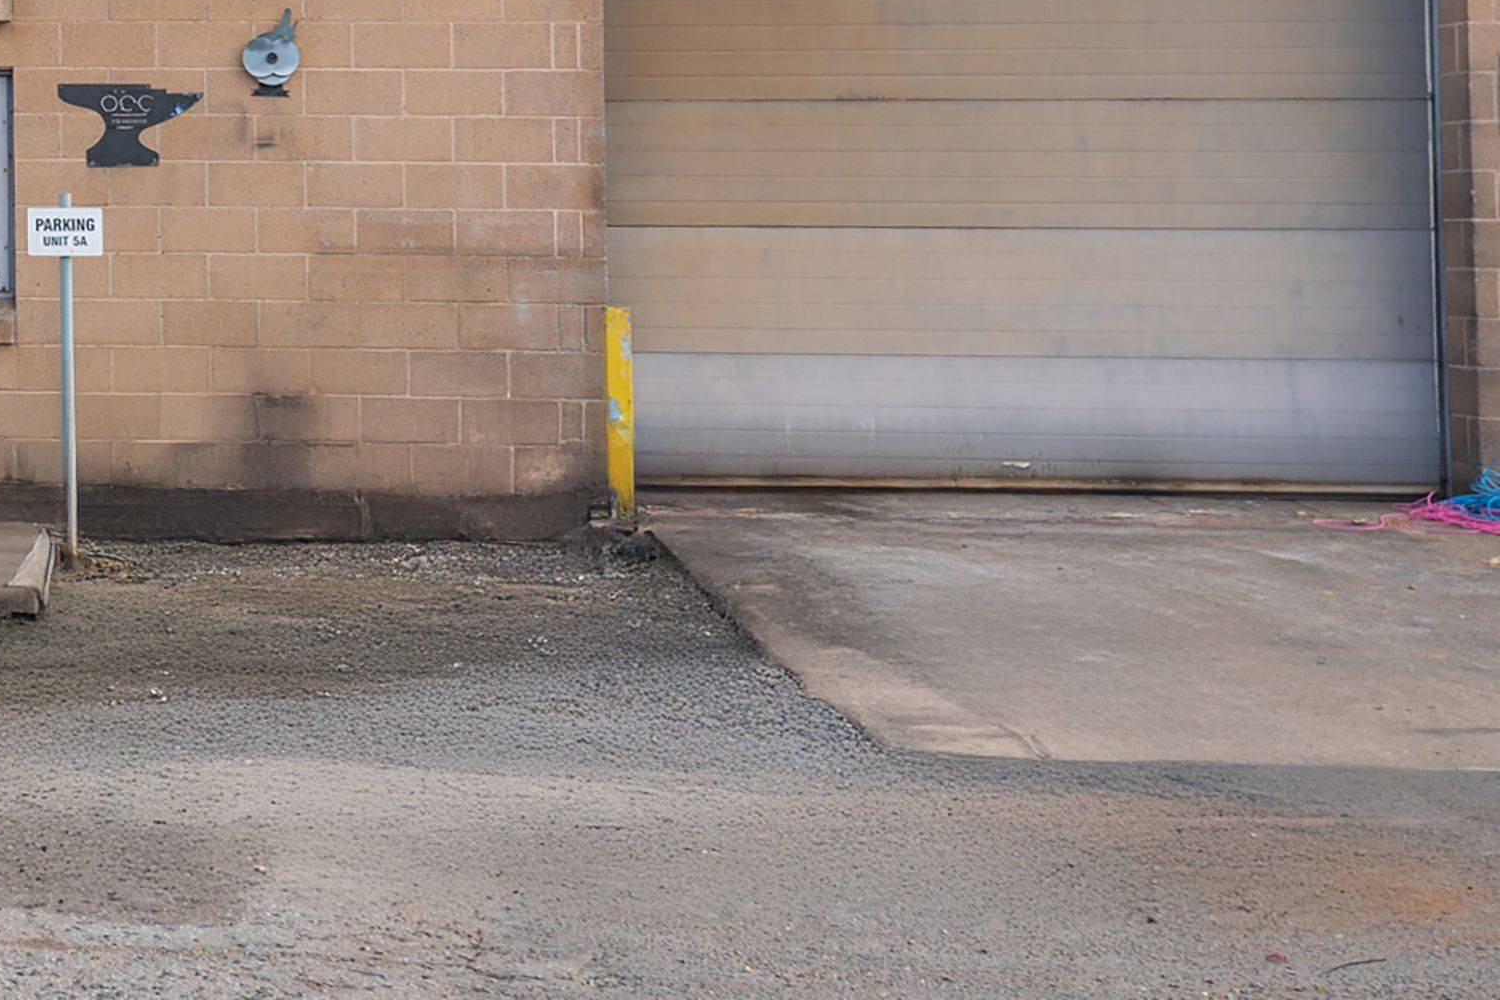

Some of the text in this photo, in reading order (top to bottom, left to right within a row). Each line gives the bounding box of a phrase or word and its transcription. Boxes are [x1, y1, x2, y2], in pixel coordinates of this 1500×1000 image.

[35, 218, 95, 231] PARKING
[43, 236, 87, 246] UNIT 5A
